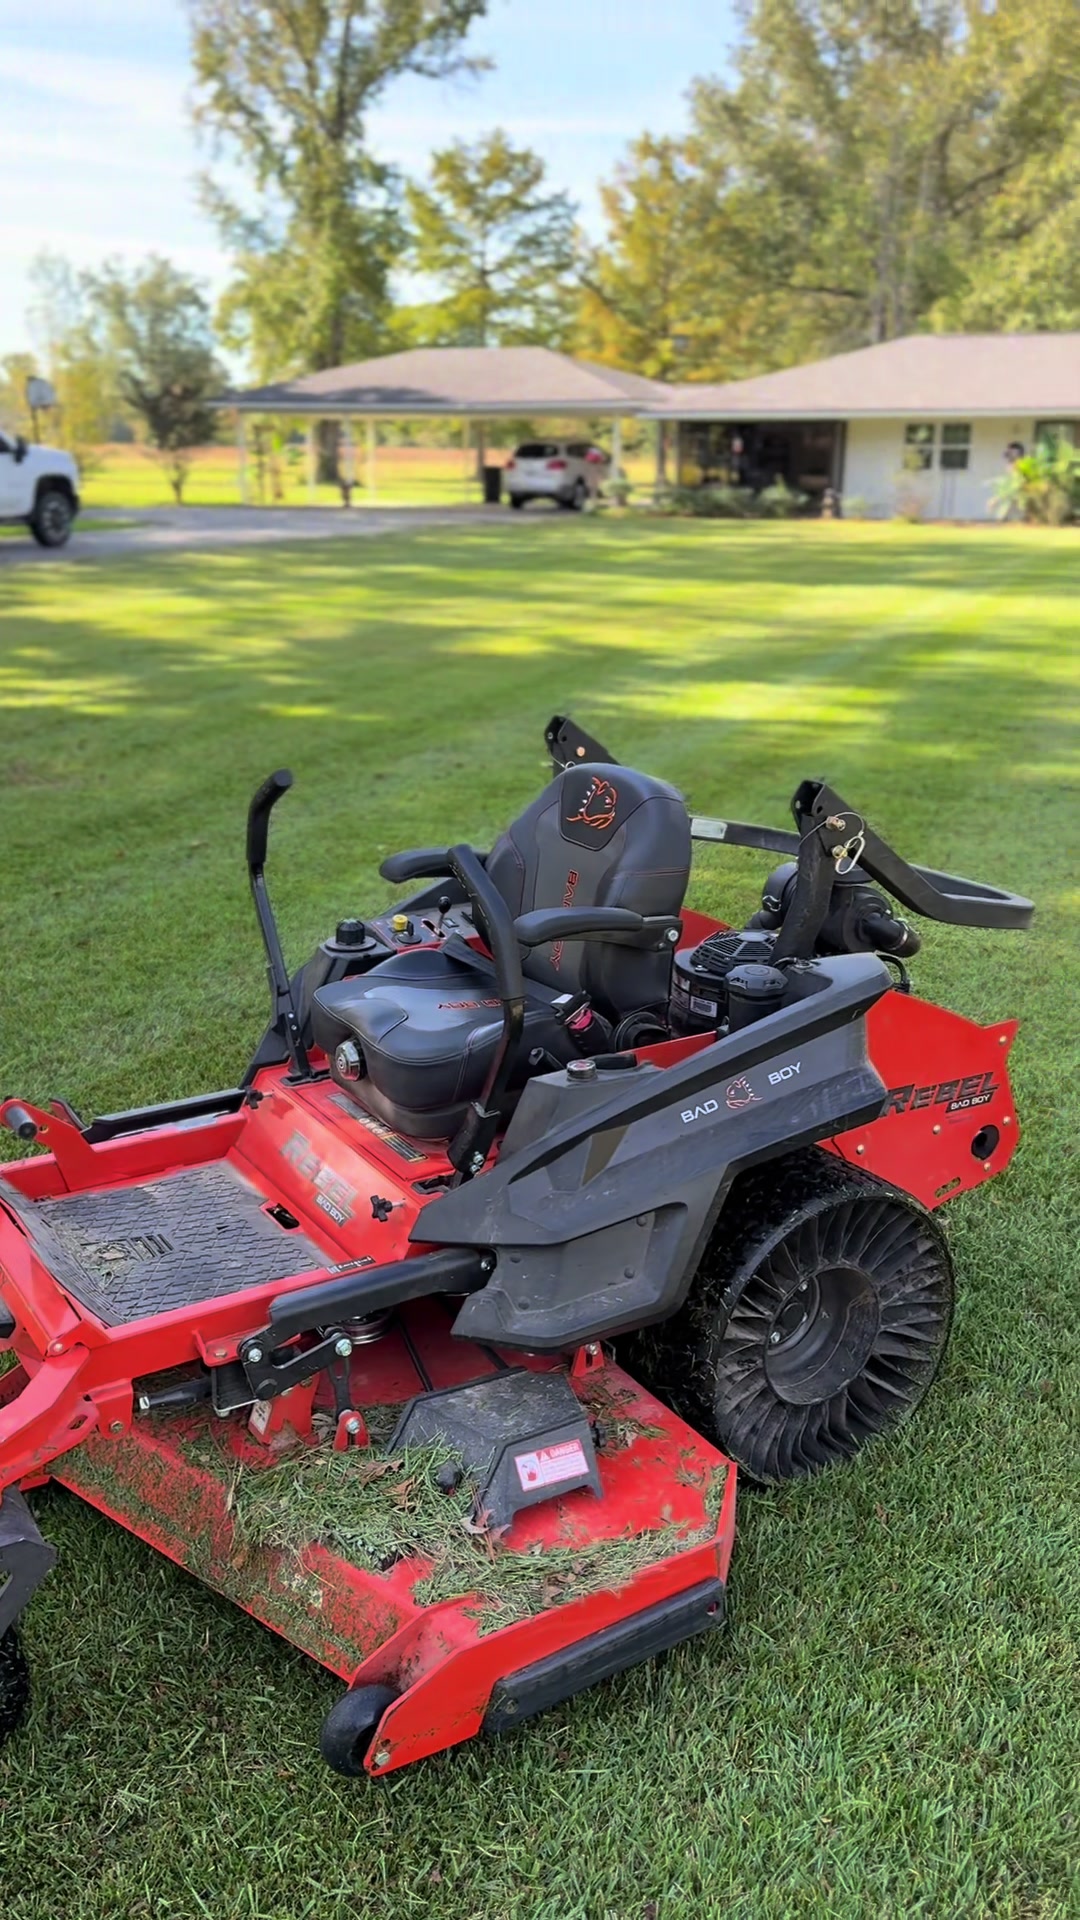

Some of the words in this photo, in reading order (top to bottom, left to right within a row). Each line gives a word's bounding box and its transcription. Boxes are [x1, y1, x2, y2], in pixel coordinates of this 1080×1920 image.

[681, 1099, 719, 1123] BAD
[768, 1062, 801, 1085] BOY
[879, 1072, 1000, 1118] REBEL
[951, 1099, 970, 1110] BAD
[971, 1094, 990, 1106] BOY
[280, 1128, 357, 1219] REBEL
[316, 1194, 332, 1212] BAD
[329, 1207, 346, 1223] BOY
